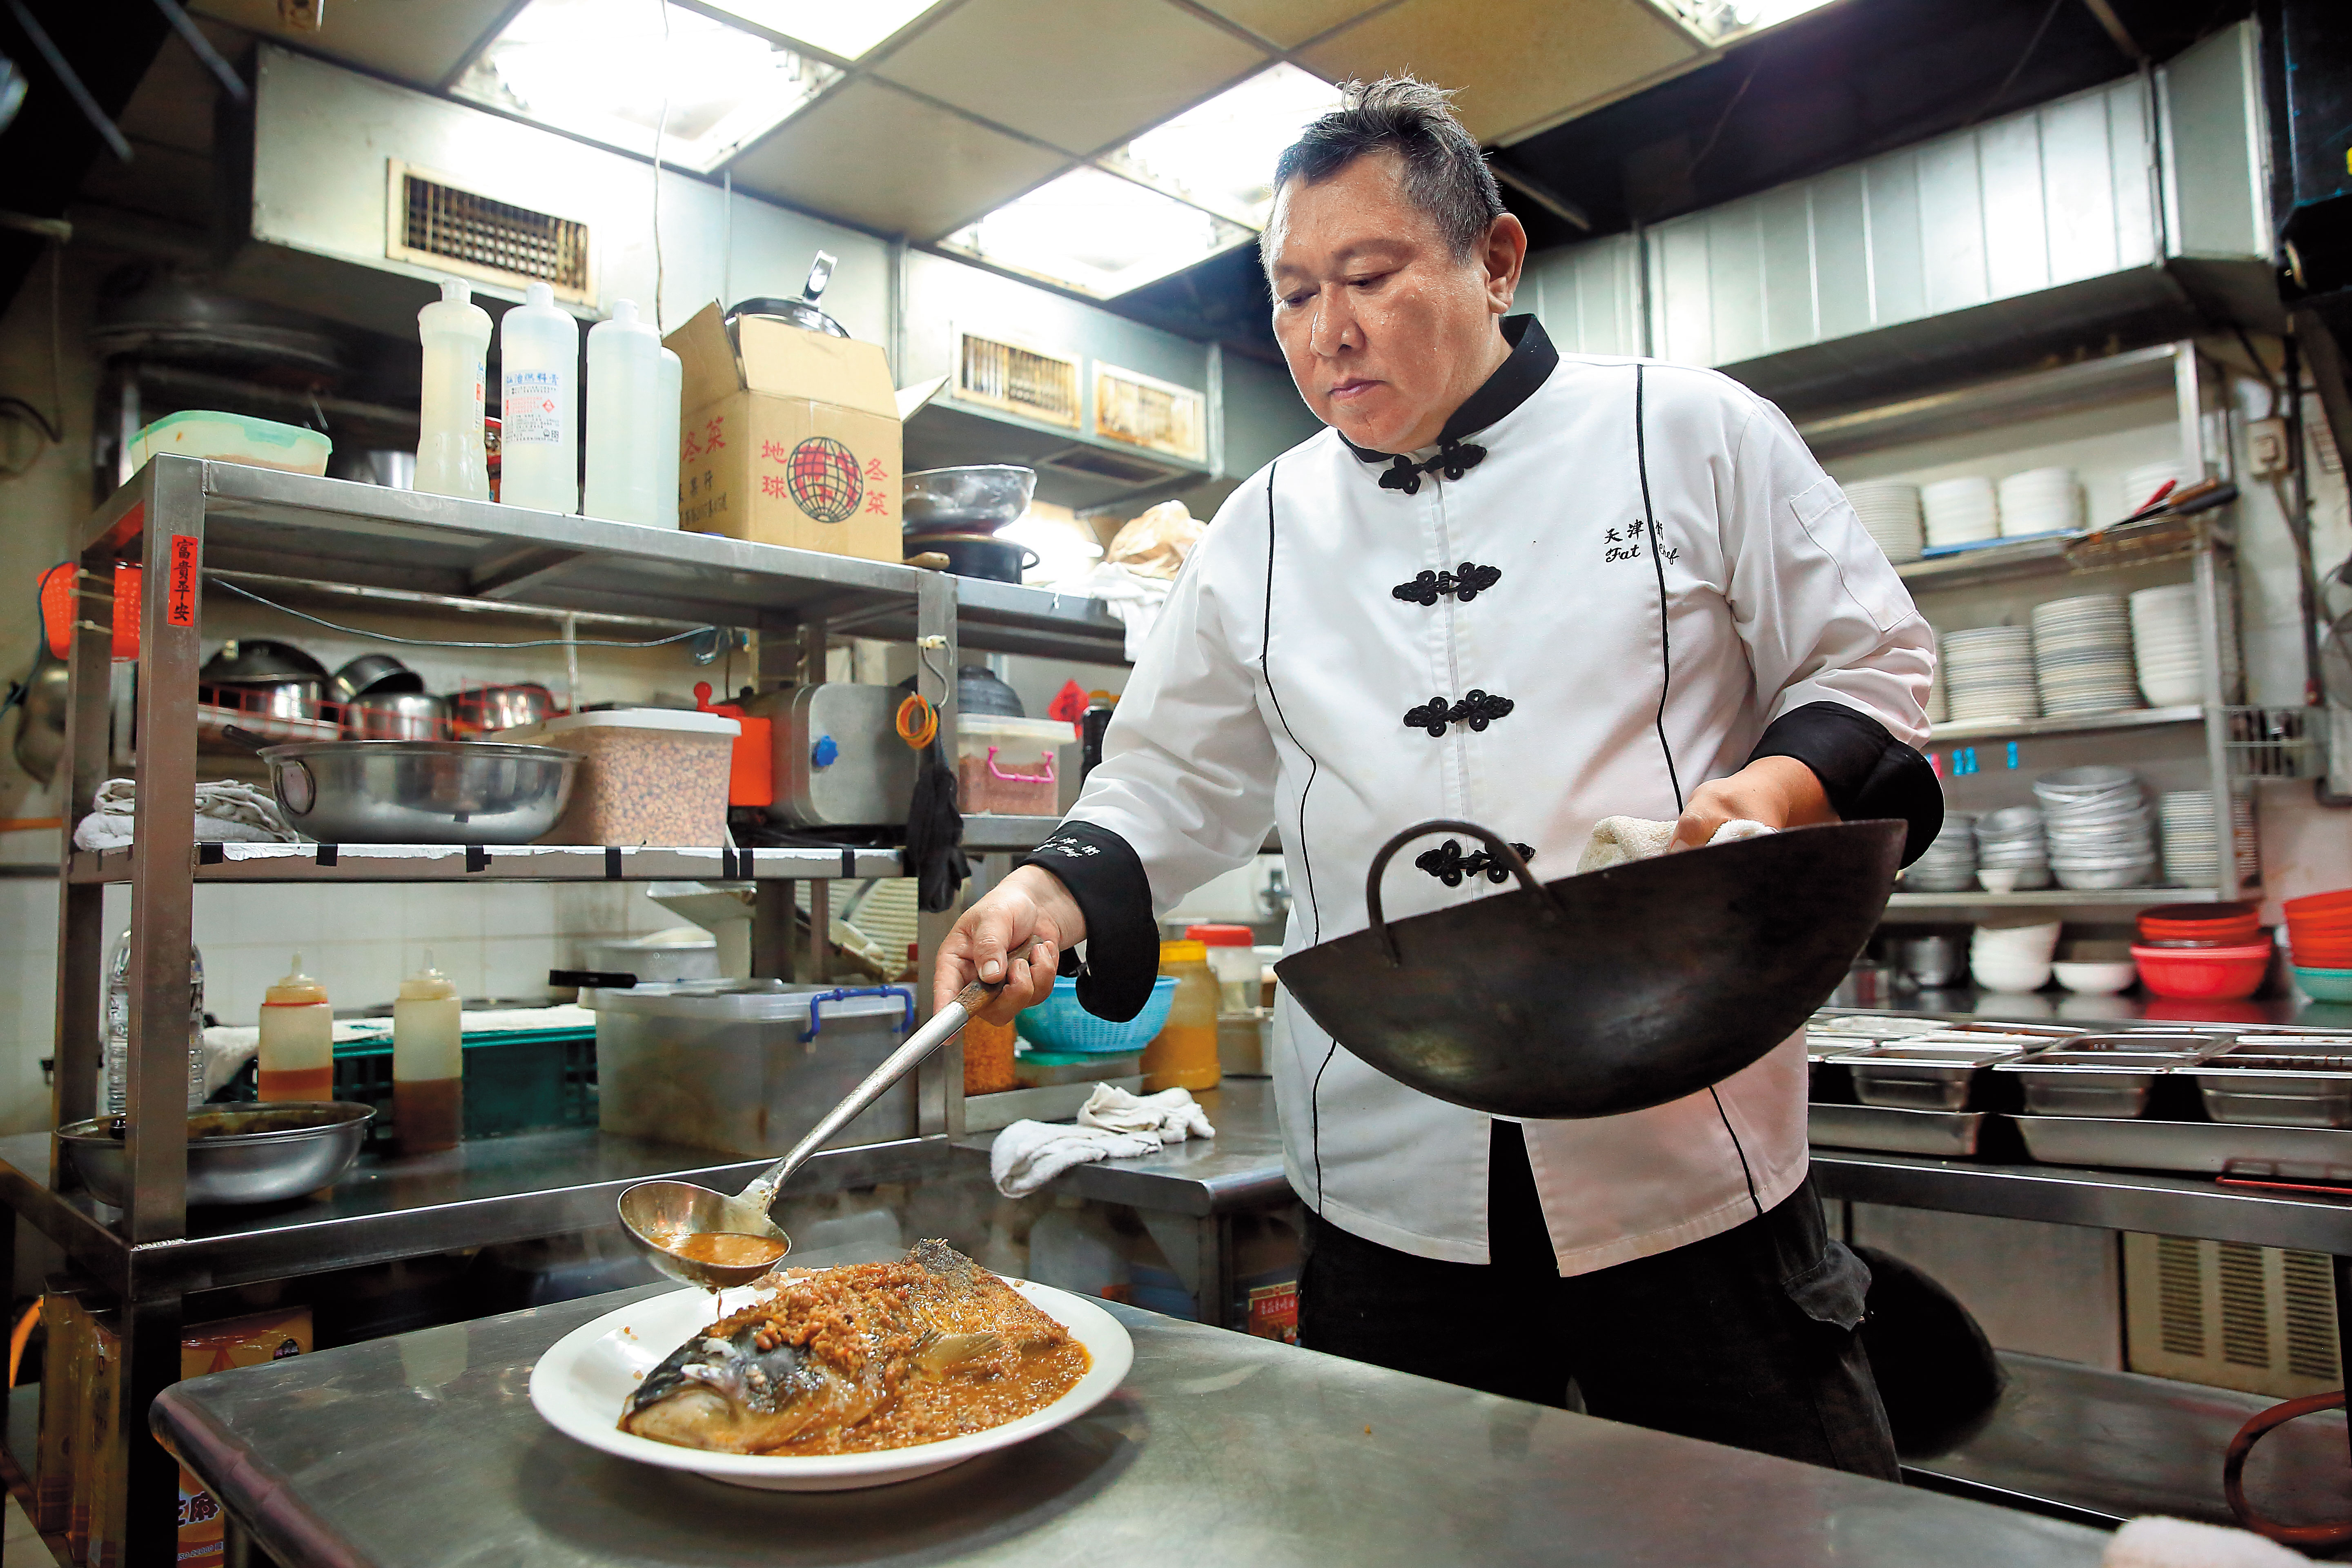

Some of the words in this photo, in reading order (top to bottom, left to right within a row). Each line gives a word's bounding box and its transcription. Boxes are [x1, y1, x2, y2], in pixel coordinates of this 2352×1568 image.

[682, 416, 726, 463] 冬菜
[762, 439, 788, 499] 地球
[864, 458, 889, 516] 冬菜
[174, 538, 194, 621] 富貴平安
[1605, 544, 1641, 563] Fat
